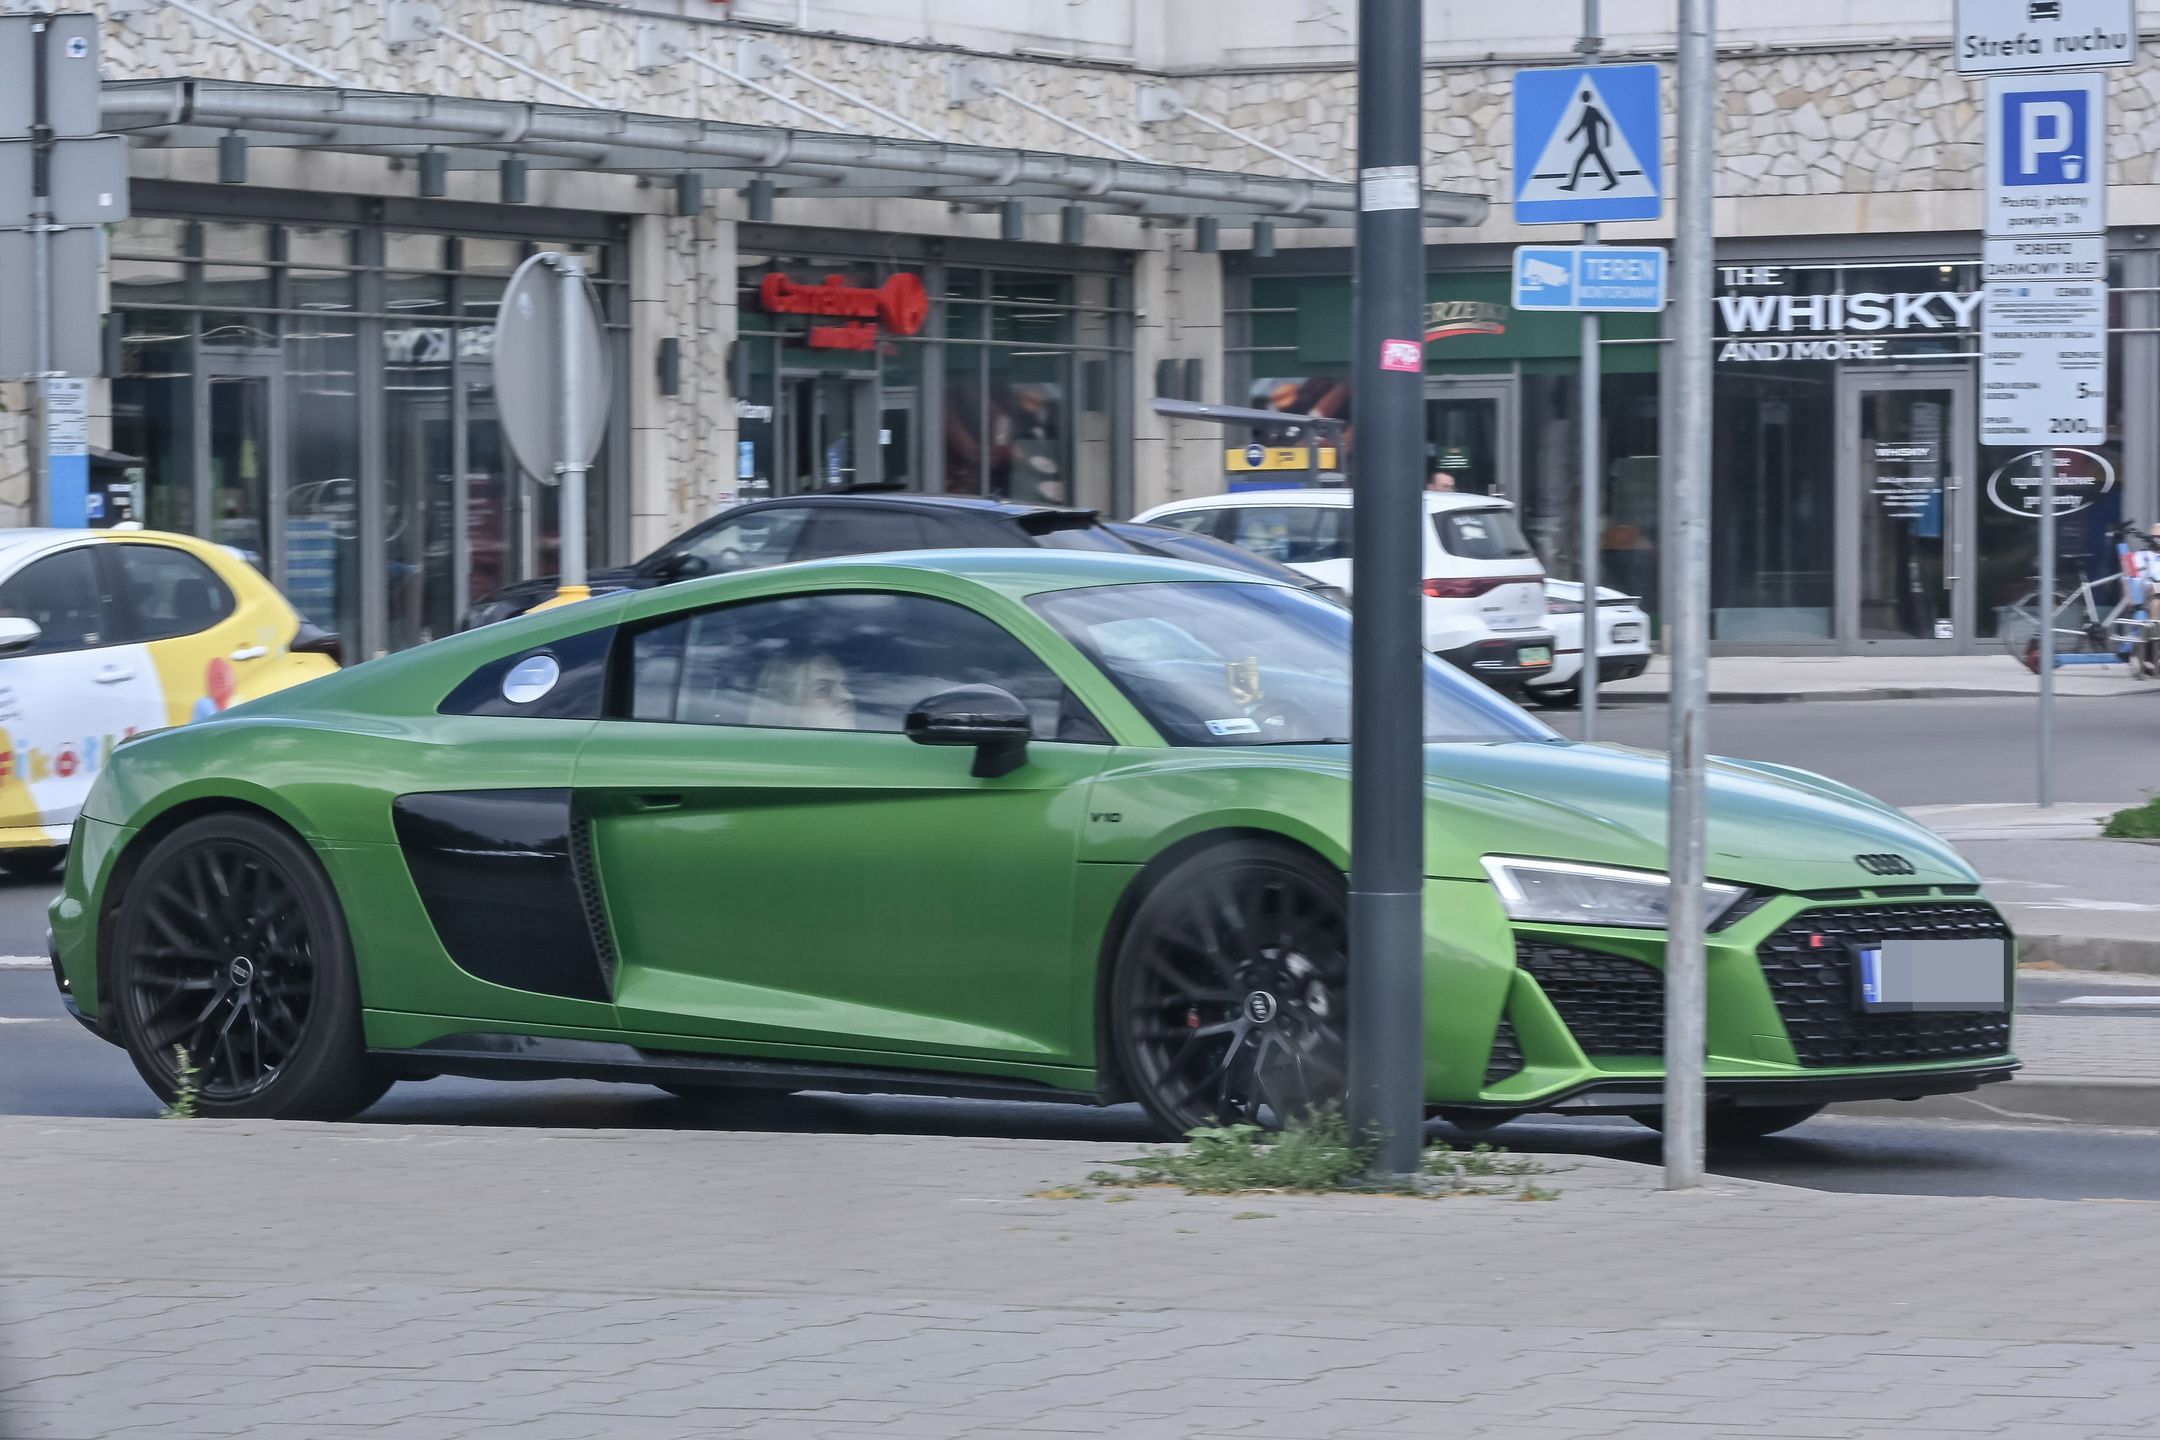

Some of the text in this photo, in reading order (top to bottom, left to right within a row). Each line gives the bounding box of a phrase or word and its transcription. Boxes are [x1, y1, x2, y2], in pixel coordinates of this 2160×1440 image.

[1963, 27, 2127, 58] Strefa ruchu
[2019, 101, 2074, 174] P
[2015, 242, 2072, 255] POBIERZ
[1584, 258, 1656, 281] TEREN
[1718, 266, 1784, 286] THE
[1987, 262, 2100, 275] DARMOWY BILET
[1718, 291, 1985, 332] WHISKY
[1718, 340, 1887, 361] AND MORE
[2077, 382, 2088, 399] 5
[2049, 418, 2086, 433] 200
